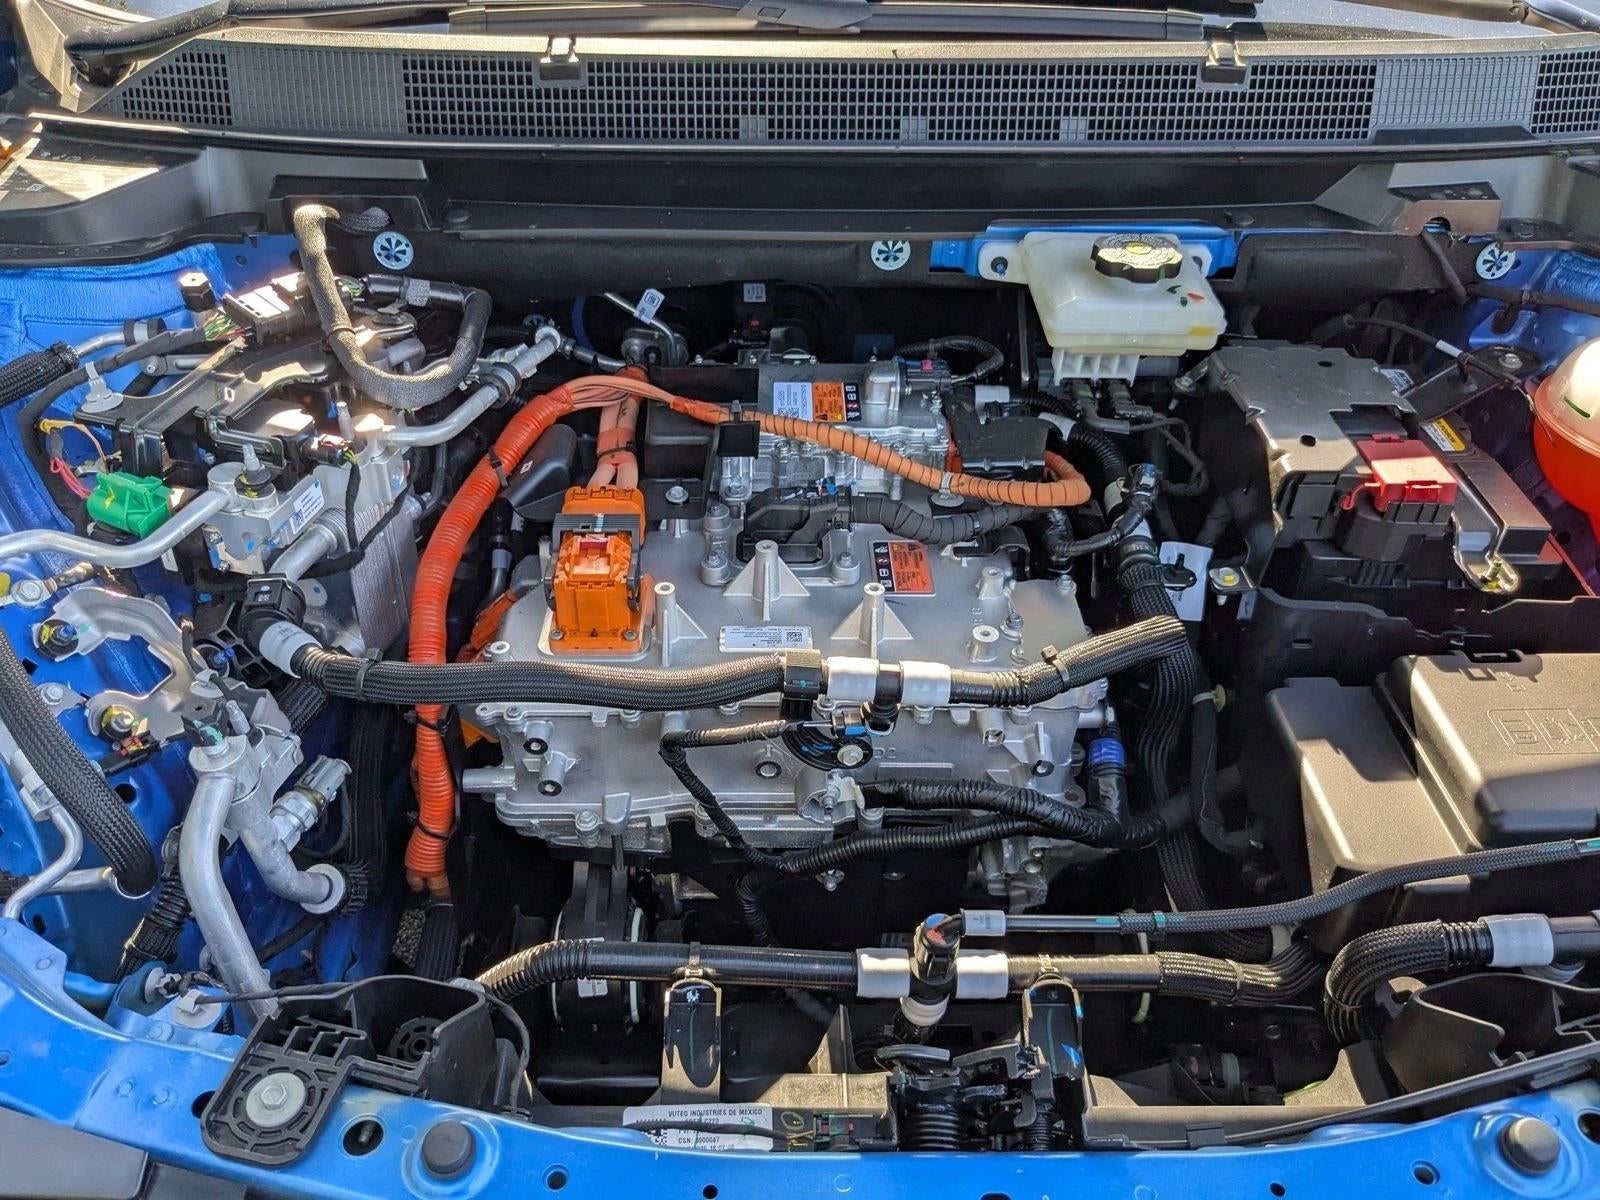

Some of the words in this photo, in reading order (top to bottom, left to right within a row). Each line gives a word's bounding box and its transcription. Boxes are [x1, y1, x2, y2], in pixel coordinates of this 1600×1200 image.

[690, 1109, 727, 1117] INDUSTRIES
[729, 1108, 737, 1116] DE
[740, 1108, 763, 1116] MEXICO
